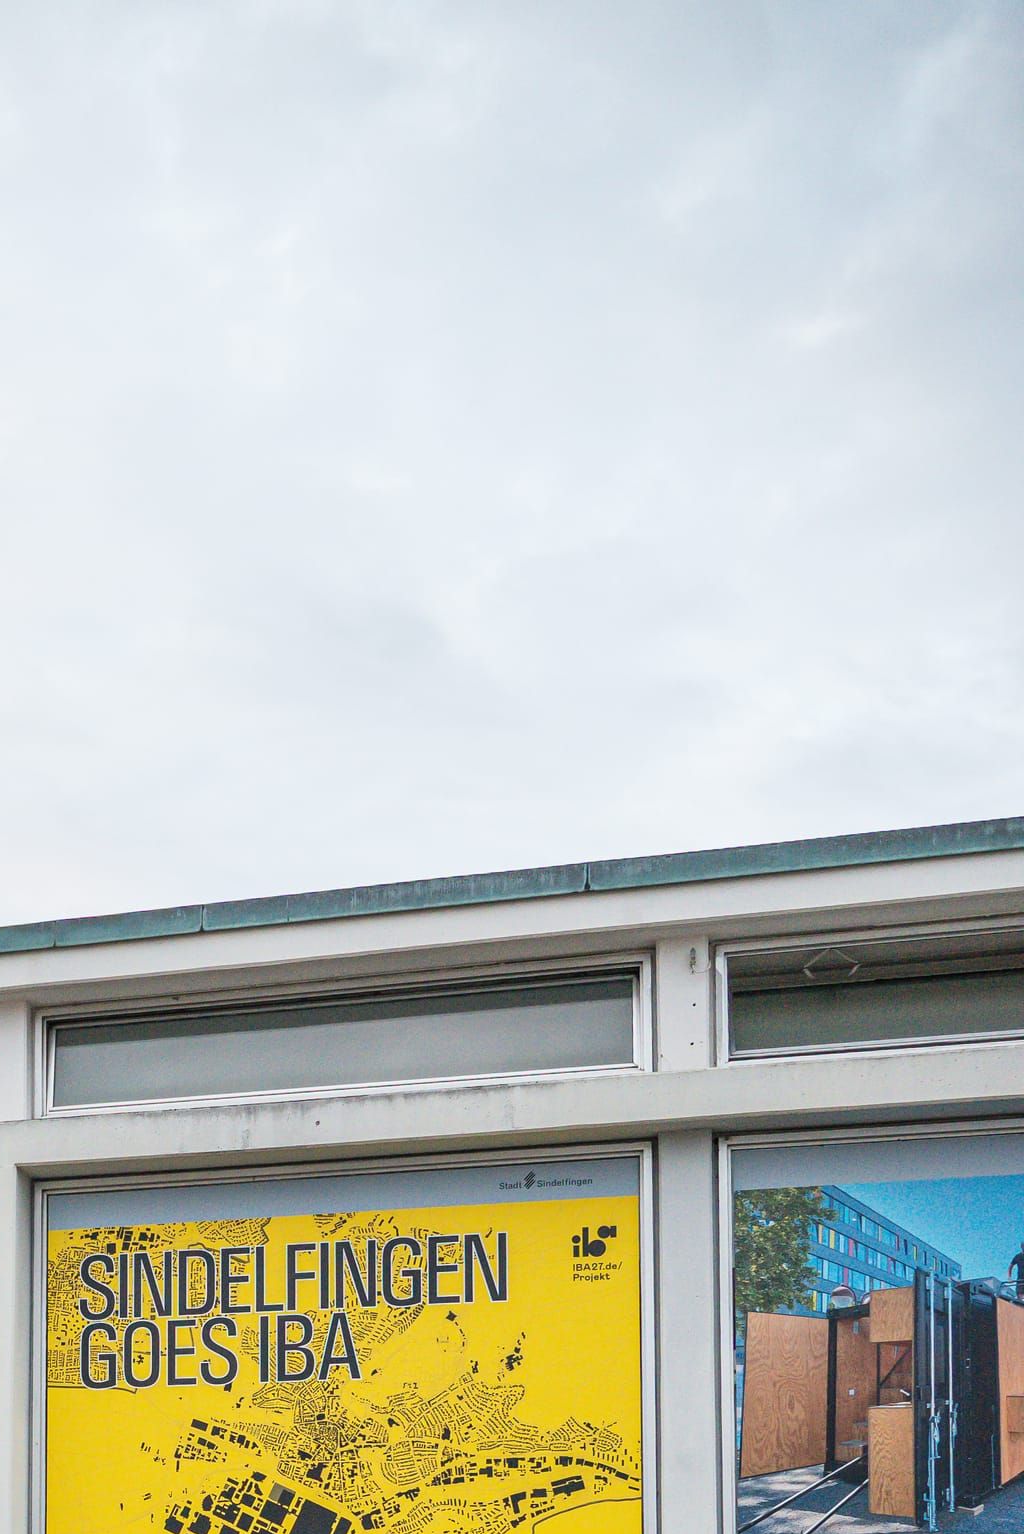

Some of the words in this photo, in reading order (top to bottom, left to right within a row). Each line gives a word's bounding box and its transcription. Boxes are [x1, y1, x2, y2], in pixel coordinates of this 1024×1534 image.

[498, 1181, 522, 1190] Stadt
[536, 1178, 593, 1188] Sindelfingen
[571, 1225, 617, 1258] iba
[77, 1232, 509, 1321] SINDELFINGEN
[573, 1261, 623, 1272] IBA27.de/
[573, 1272, 611, 1283] Projekt
[79, 1316, 240, 1390] GOES
[258, 1311, 362, 1383] IBA
